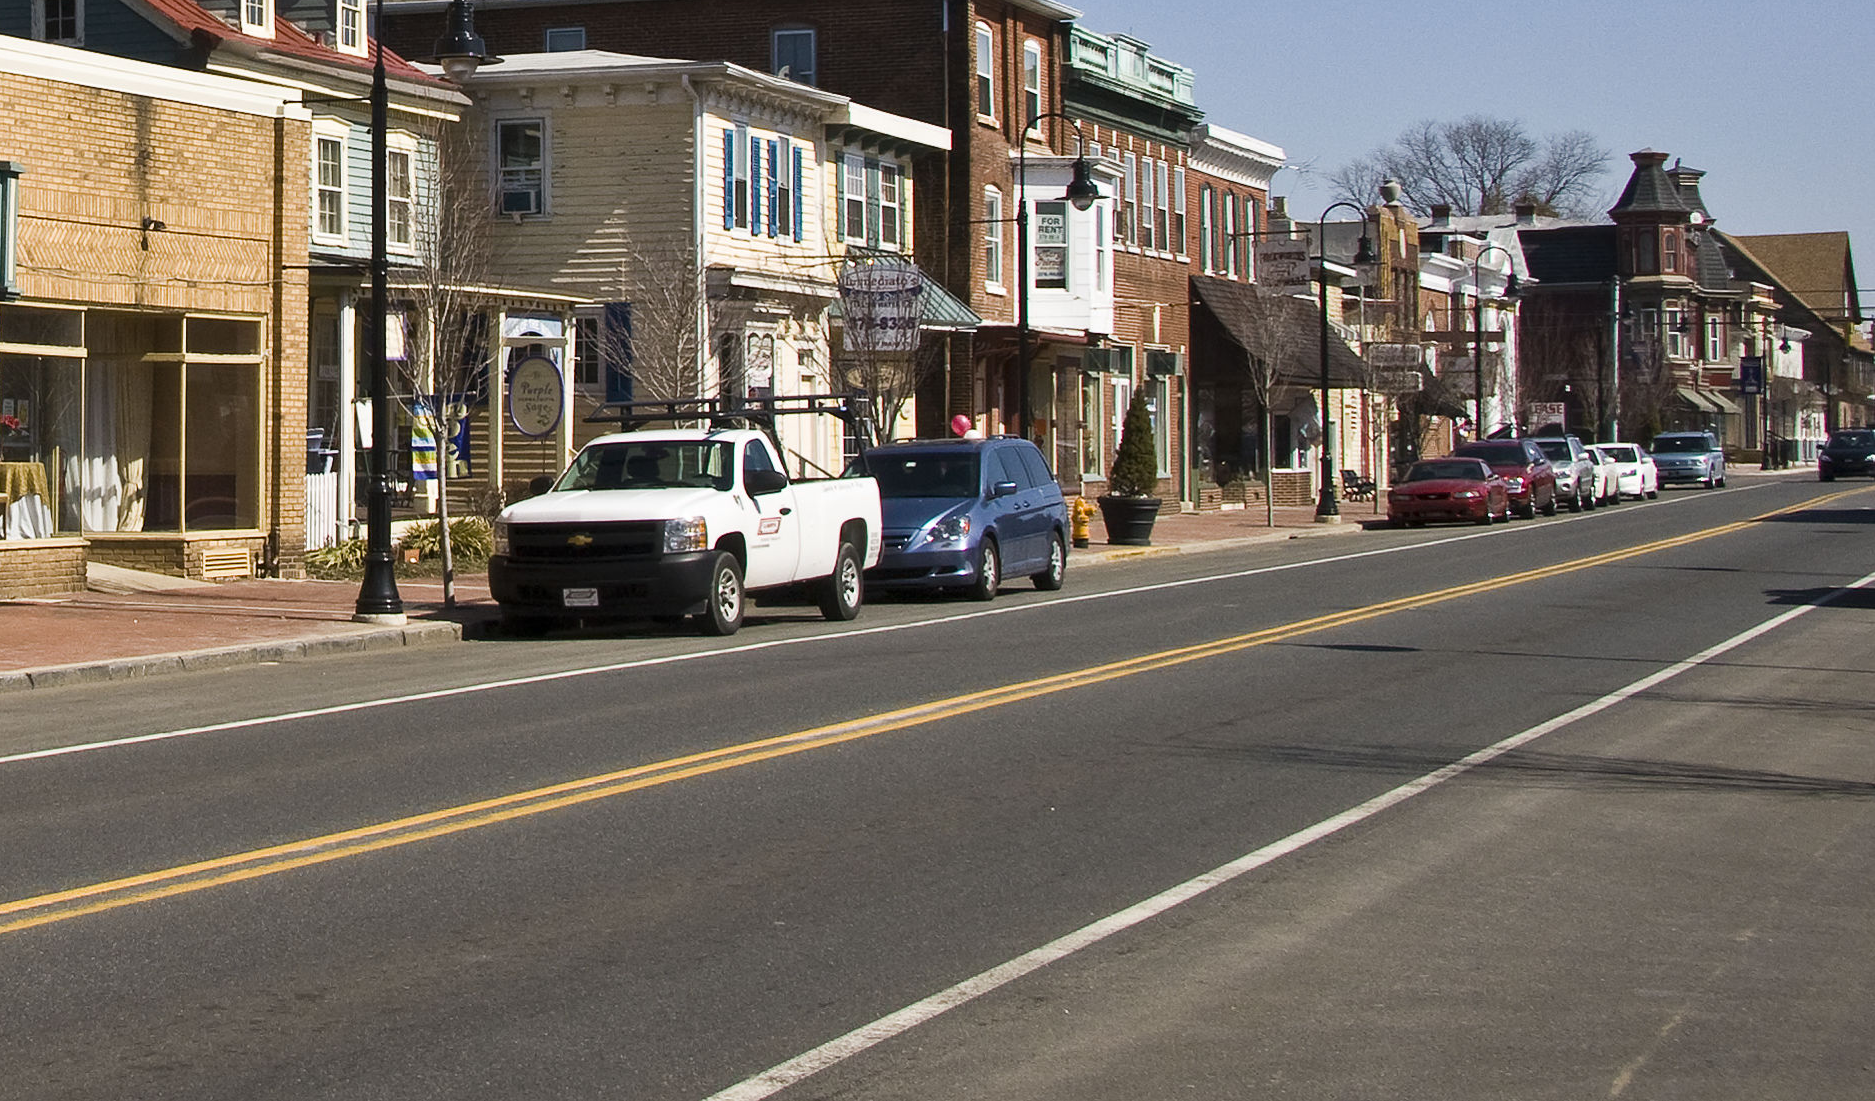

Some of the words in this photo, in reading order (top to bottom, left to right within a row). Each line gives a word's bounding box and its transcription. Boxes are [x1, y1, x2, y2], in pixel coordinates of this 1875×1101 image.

[1041, 217, 1060, 225] FOR
[1038, 225, 1063, 233] RENT
[520, 381, 553, 399] Purple
[524, 402, 550, 417] Sage
